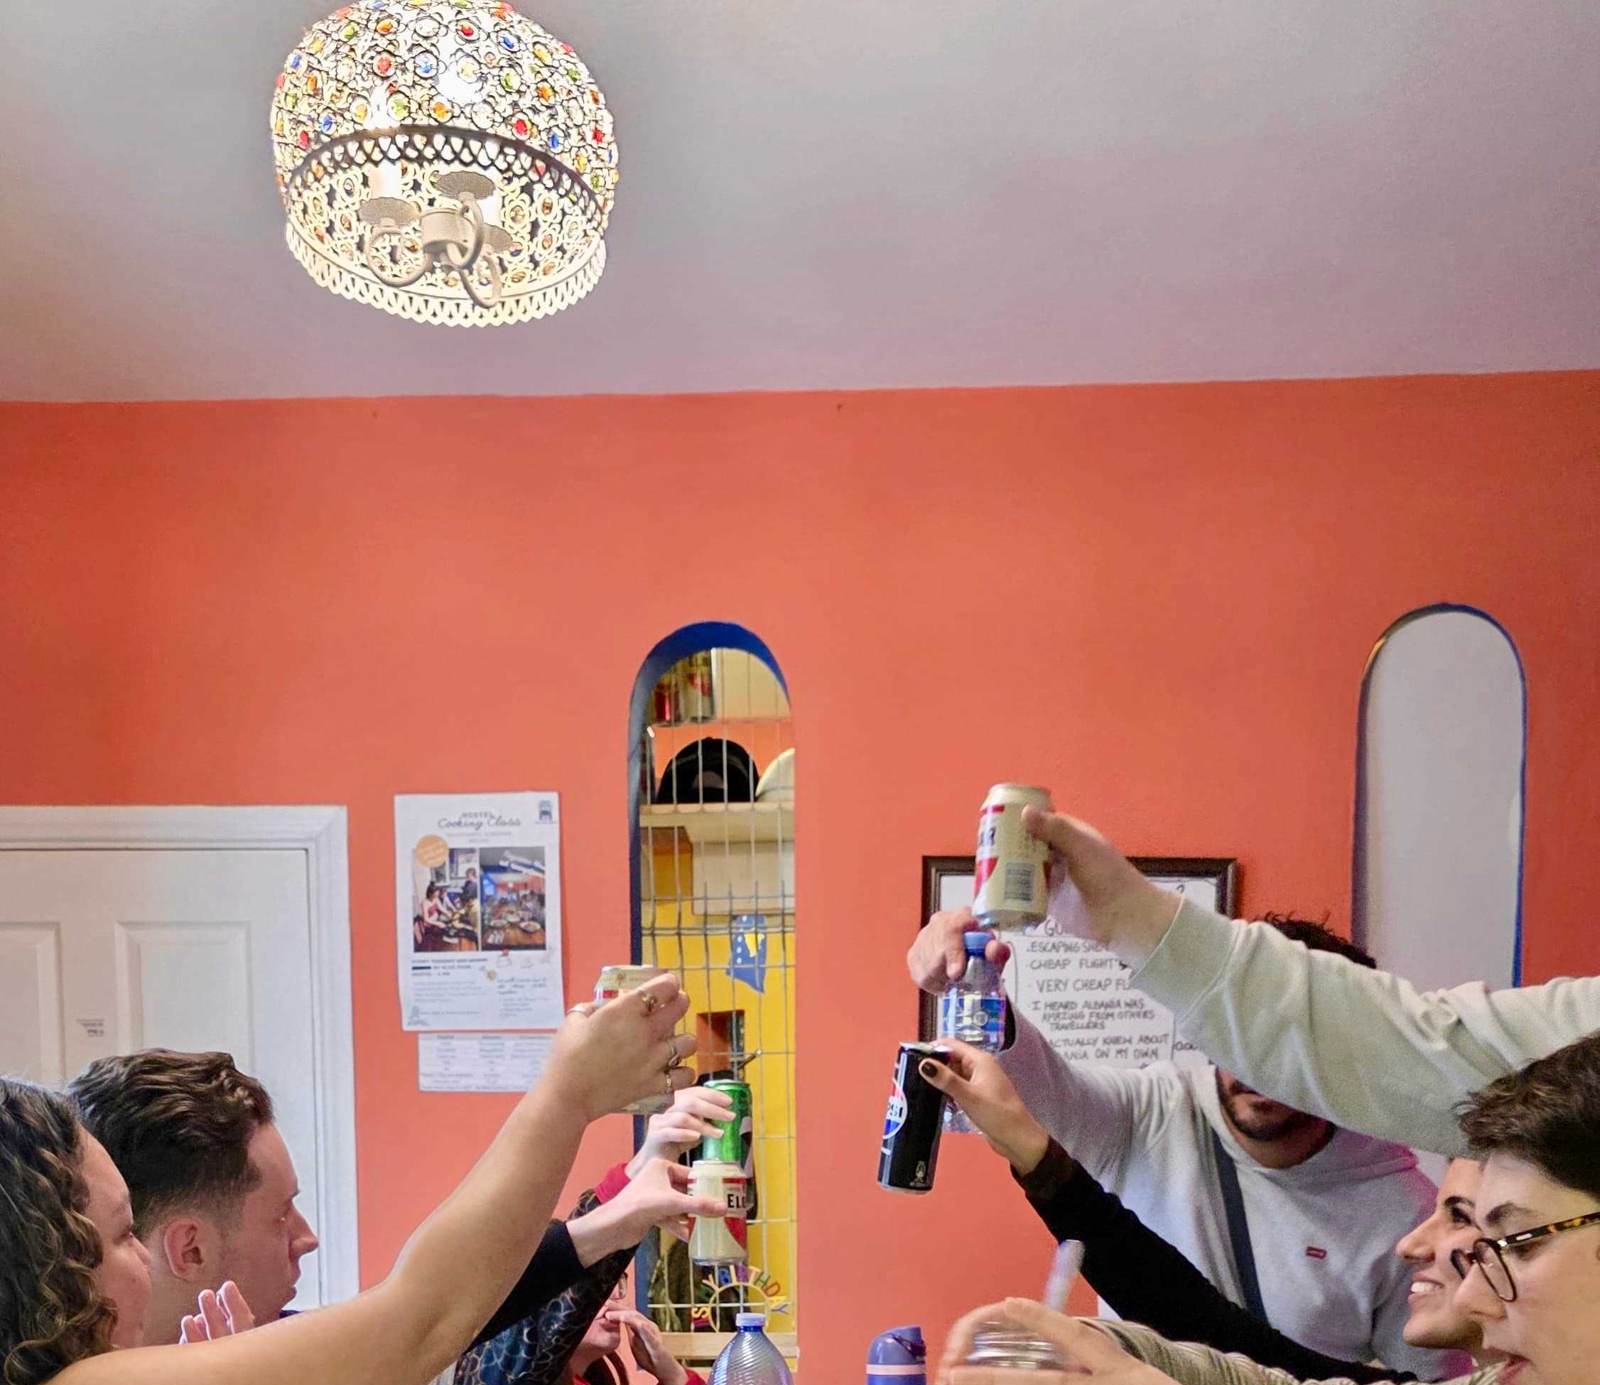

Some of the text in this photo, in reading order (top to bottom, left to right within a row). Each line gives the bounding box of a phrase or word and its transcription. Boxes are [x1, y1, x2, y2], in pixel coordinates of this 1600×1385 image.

[437, 815, 522, 831] Cooking Class
[1030, 940, 1080, 953] ESCAPING
[1029, 957, 1118, 970] CHEAP FLIGHT
[1036, 978, 1132, 993] VERY CHEAP FL
[1032, 999, 1145, 1011] I HEARD ALBANIA WAS
[1042, 1009, 1156, 1022] AMAZING FROM OTHERS
[1050, 1022, 1106, 1032] TRAVELLERS
[1102, 1035, 1133, 1046] KNEW
[1137, 1034, 1170, 1045] ABOUT
[1094, 1050, 1111, 1060] ON
[1115, 1049, 1129, 1059] MY
[1133, 1049, 1159, 1060] OWN
